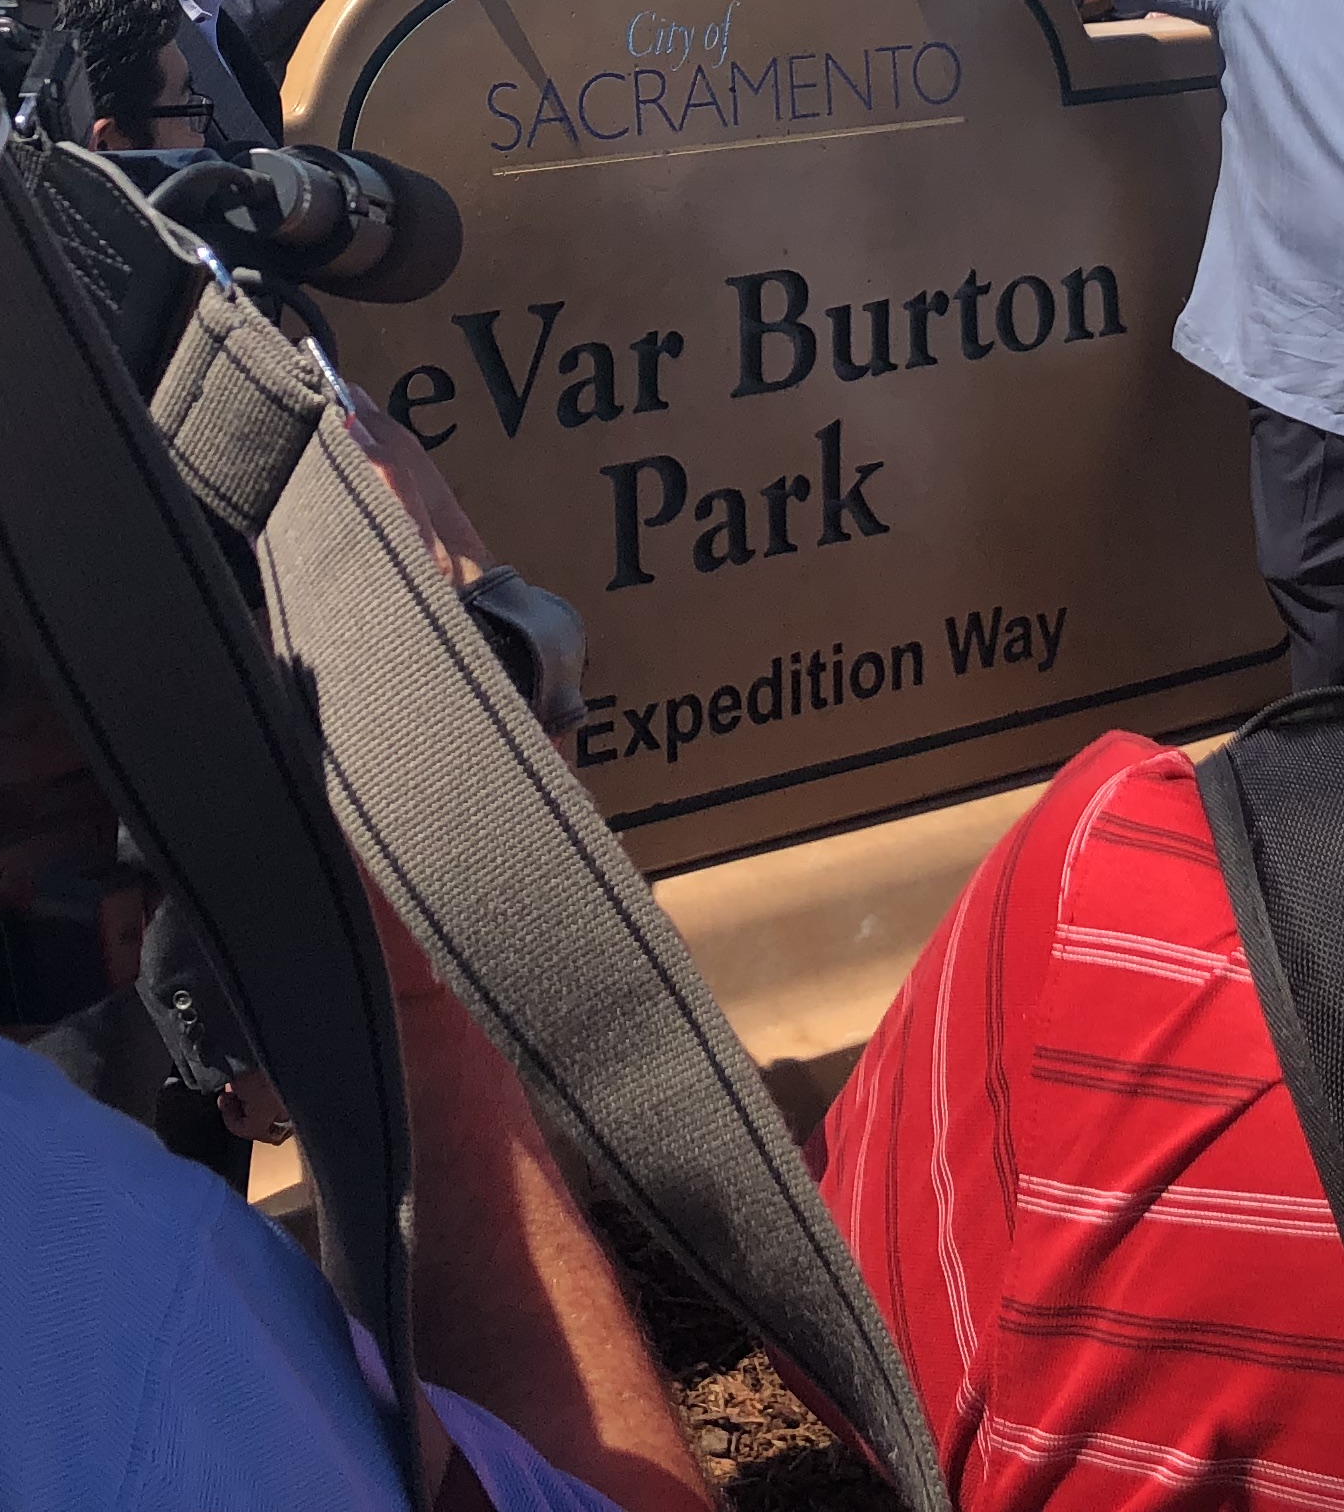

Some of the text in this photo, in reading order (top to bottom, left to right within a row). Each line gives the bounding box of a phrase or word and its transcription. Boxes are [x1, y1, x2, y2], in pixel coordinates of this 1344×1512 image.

[486, 40, 962, 152] SACRAMENTO
[626, 0, 742, 71] City of
[387, 264, 1128, 452] eVar Burton
[599, 418, 891, 591] Park
[575, 605, 1068, 769] Expedition Way
